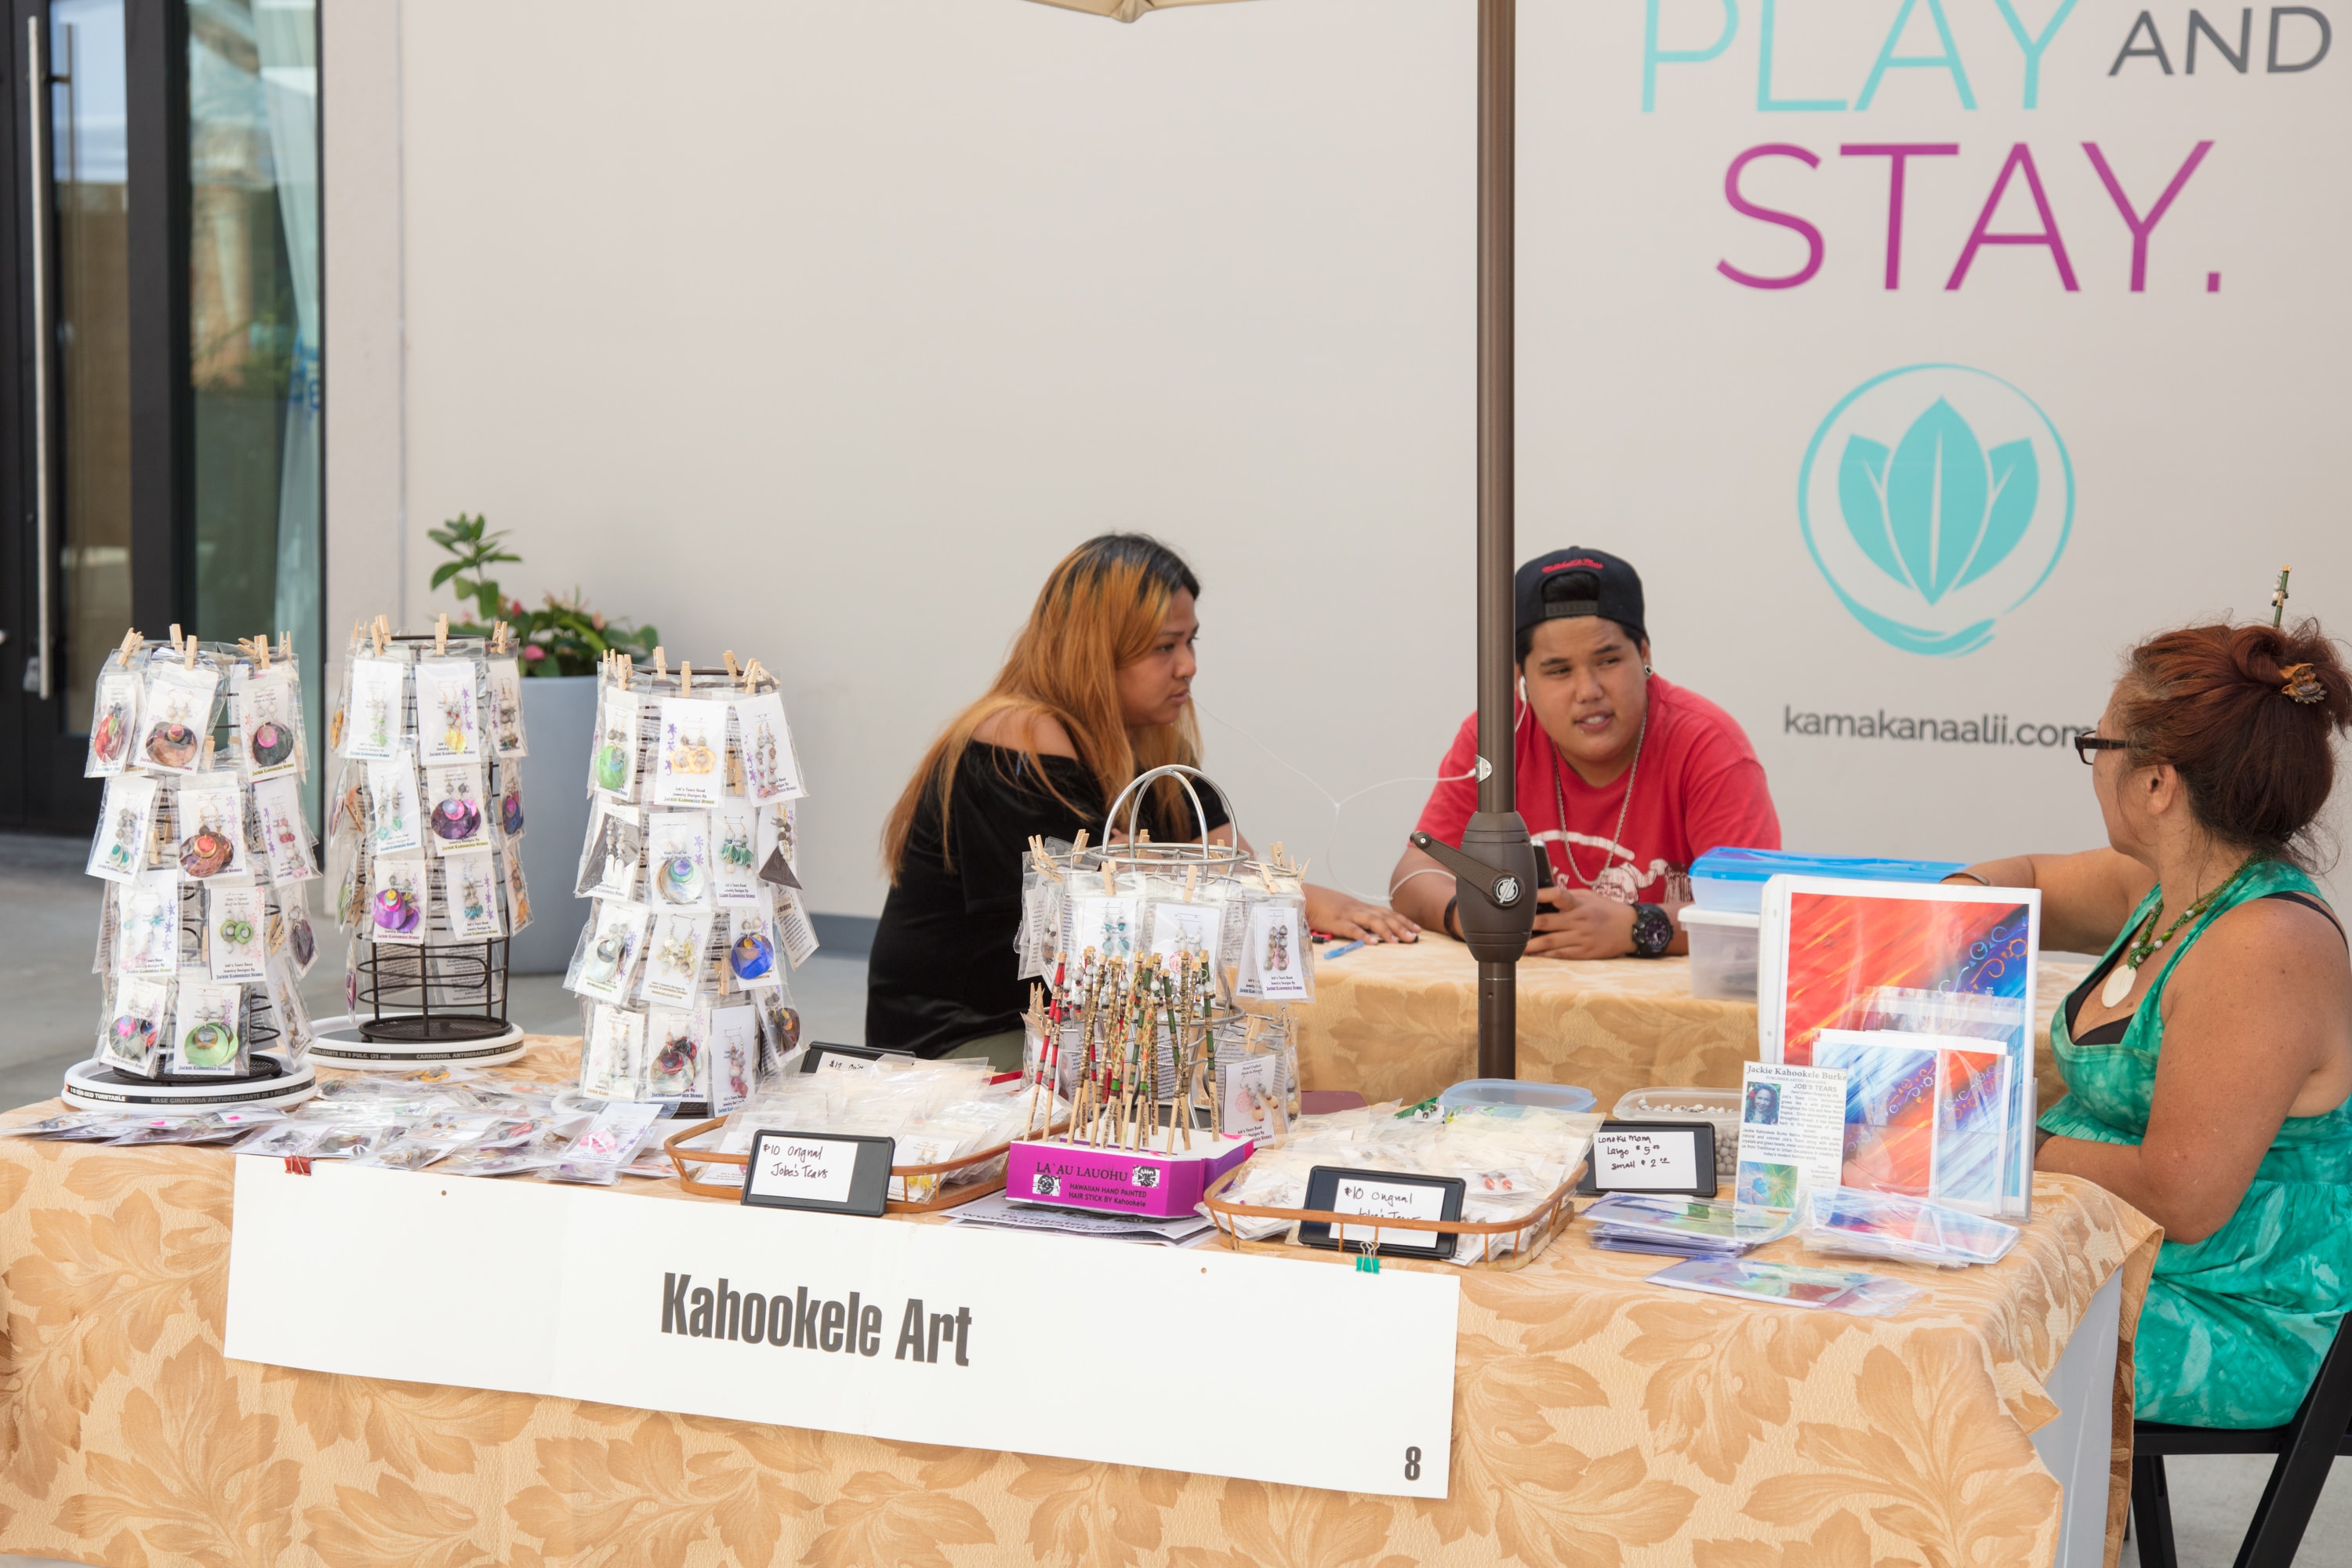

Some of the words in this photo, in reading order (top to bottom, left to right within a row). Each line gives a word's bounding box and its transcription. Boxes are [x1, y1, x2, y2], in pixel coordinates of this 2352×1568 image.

[1641, 0, 2078, 112] PLAY
[2107, 6, 2332, 76] AND
[1716, 140, 2222, 294] STAY.
[1747, 1065, 1773, 1074] Jackie
[1775, 1068, 1820, 1079] Kahookele
[1822, 1073, 1847, 1081] Burke
[764, 1144, 780, 1156] $10
[802, 1165, 828, 1178] Tears
[1077, 1167, 1128, 1181] LAUOHU
[1069, 1183, 1100, 1192] HAWAIIAN
[1114, 1197, 1146, 1207] Kahookele
[662, 1272, 882, 1357] Kahookele
[895, 1298, 972, 1367] Art
[1404, 1446, 1421, 1481] 8
